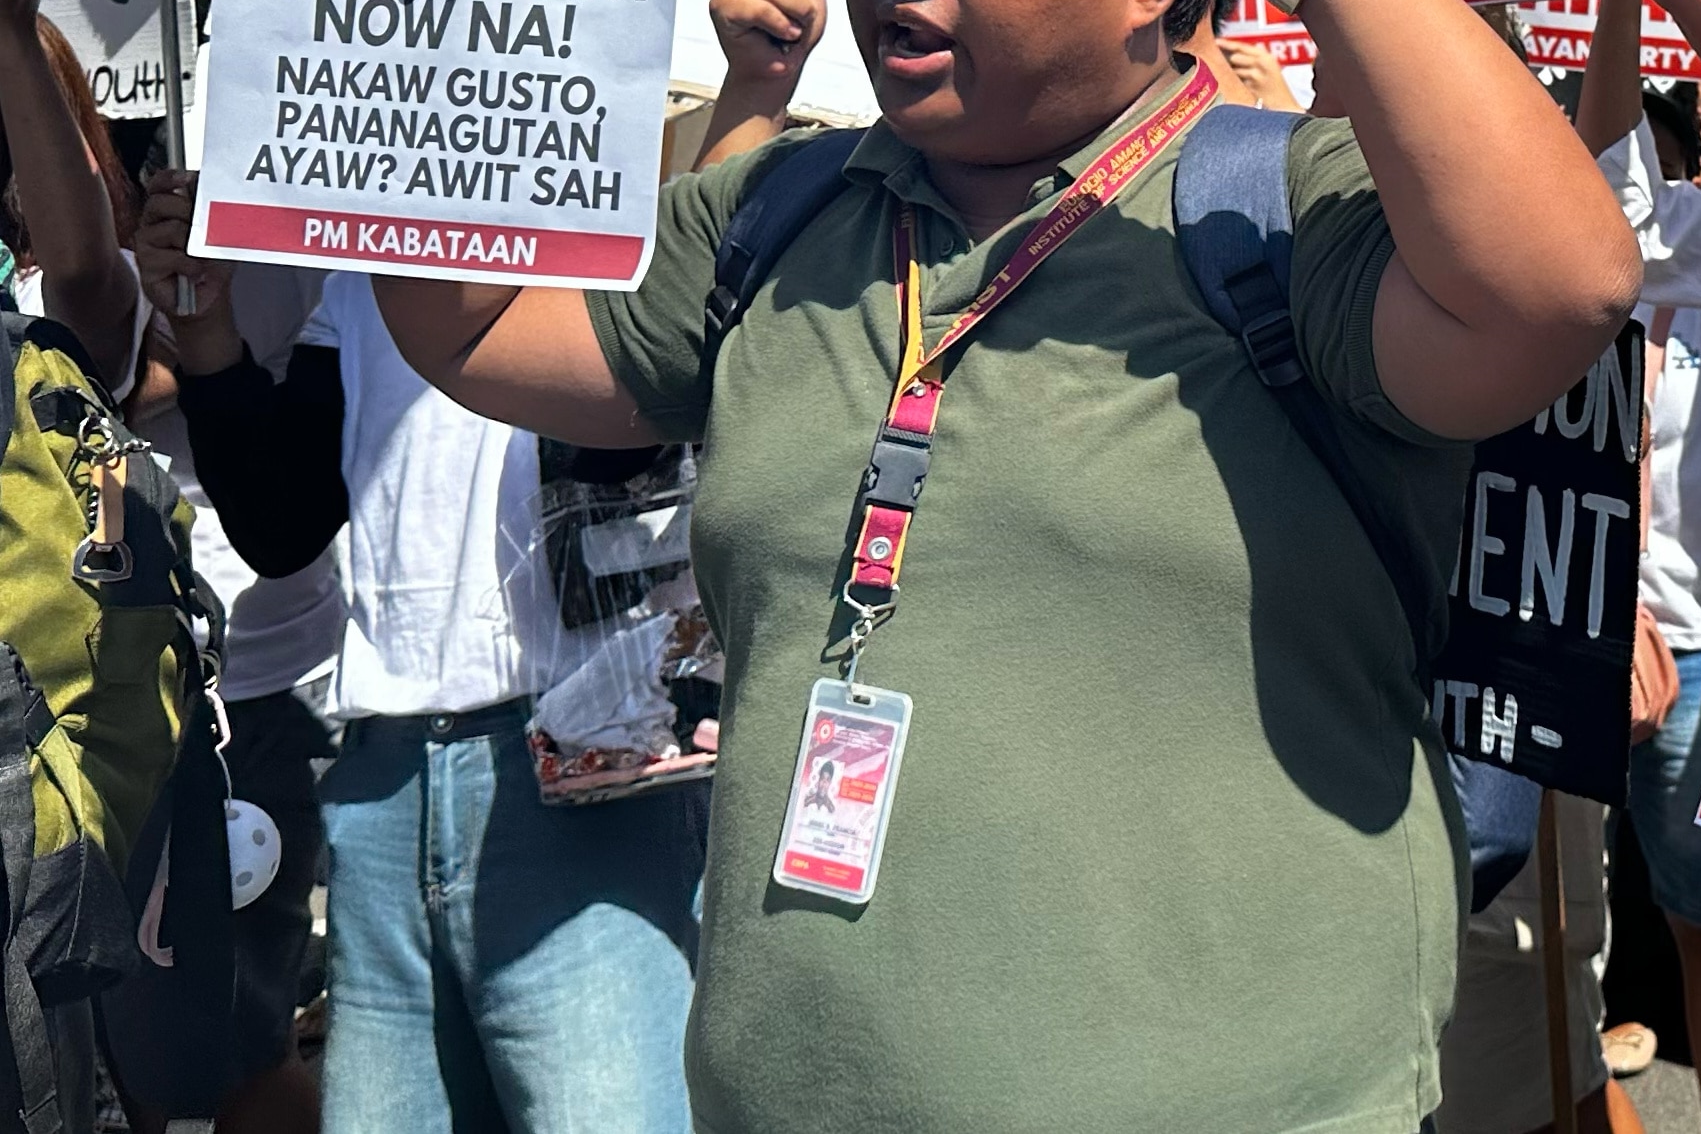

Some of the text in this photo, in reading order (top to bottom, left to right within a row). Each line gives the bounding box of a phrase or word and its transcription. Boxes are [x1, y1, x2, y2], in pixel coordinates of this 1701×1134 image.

[467, 2, 577, 59] NA!
[276, 55, 607, 124] NAKAW GUSTO,
[276, 101, 602, 162] PANANAGUTAN
[246, 144, 622, 211] AYAW? AWIT SAH
[304, 217, 538, 266] PM KABATAAN
[1028, 198, 1090, 256] INSTITUTE
[1447, 470, 1631, 640] ENT
